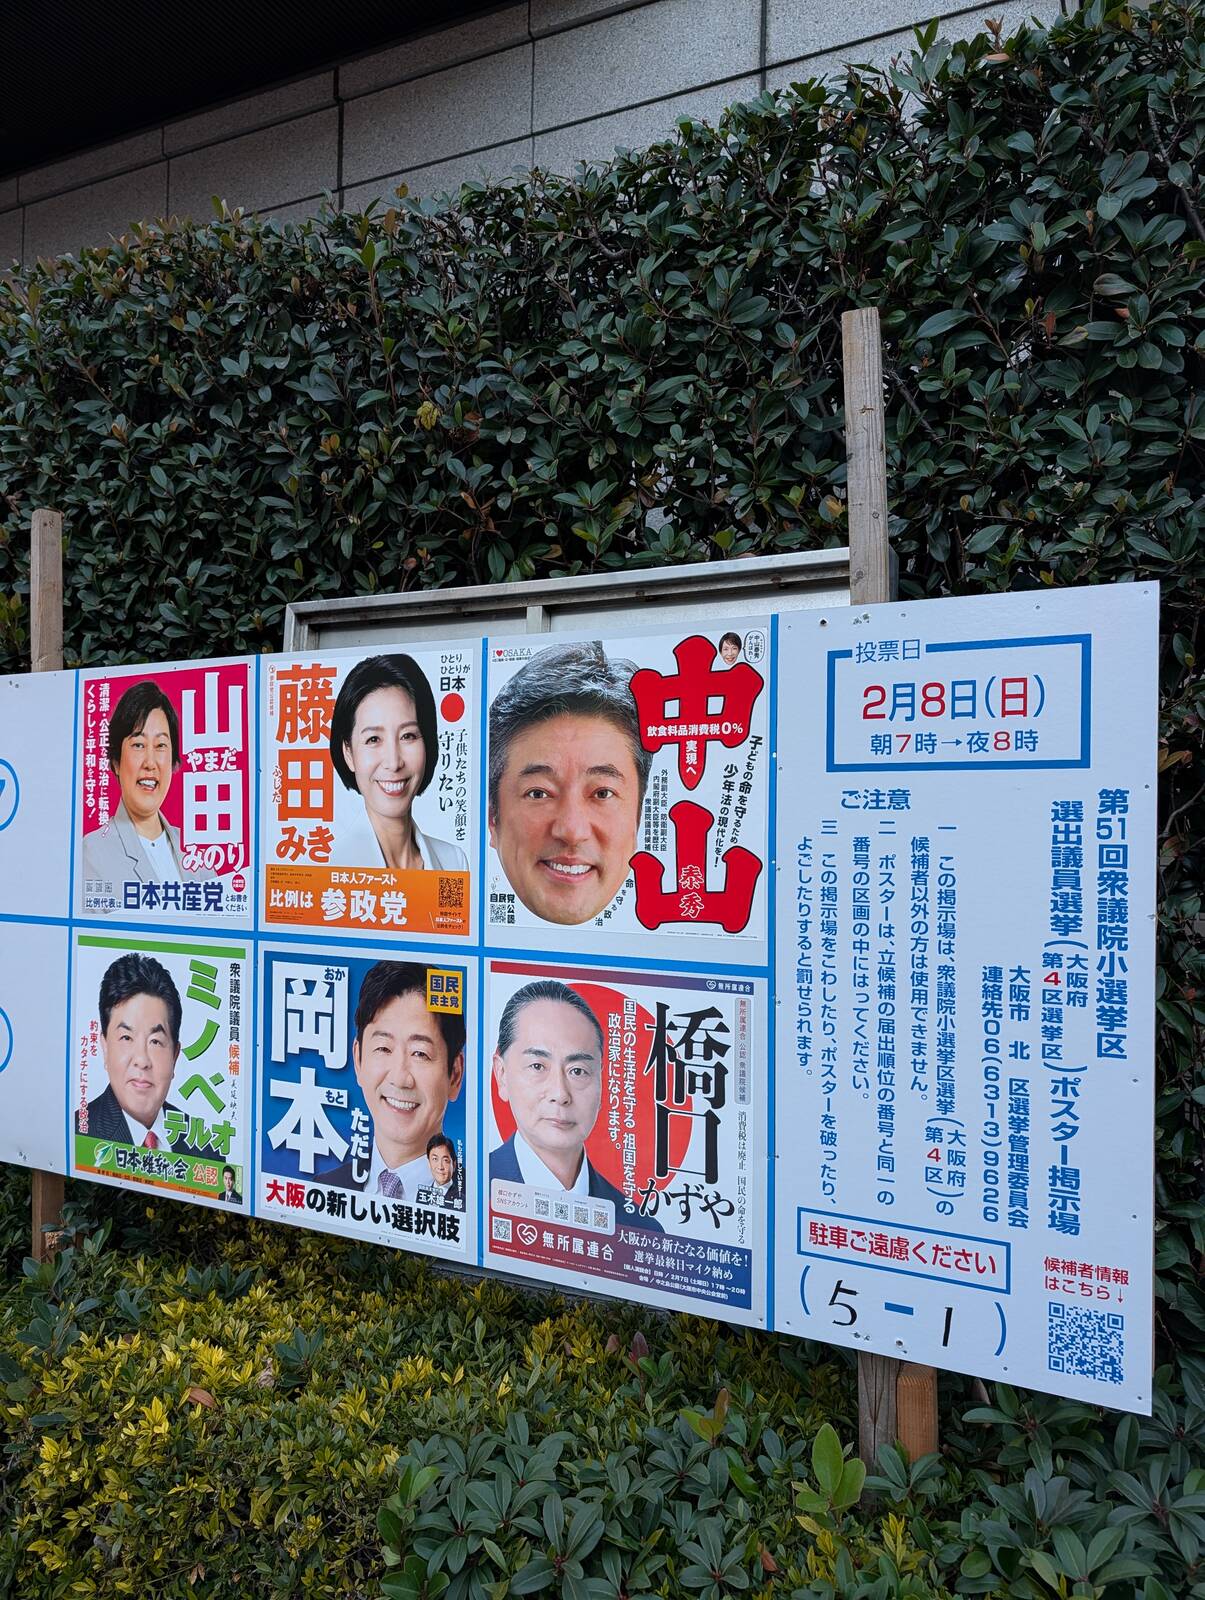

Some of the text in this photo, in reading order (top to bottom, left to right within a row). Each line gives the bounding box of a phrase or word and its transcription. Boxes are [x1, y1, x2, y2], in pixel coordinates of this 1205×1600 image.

[441, 654, 462, 663] ひとり
[441, 664, 470, 674] ひとりが
[503, 648, 532, 657] OSAKA
[856, 639, 921, 663] 投票日
[440, 676, 465, 692] 日本
[862, 674, 1045, 722] 2月8日(日)
[276, 663, 337, 822] 藤田
[647, 722, 743, 737] 飲食料品消費税0%
[870, 729, 1039, 756] 朝7時 夜8時
[181, 672, 243, 846] 山田
[187, 748, 237, 772] やまだ
[438, 731, 454, 812] 守りたい
[685, 740, 698, 775] 実現へ
[272, 766, 283, 804] ふじた
[454, 729, 467, 841] 子供たちの笑顔を
[629, 634, 764, 933] 中山
[730, 735, 763, 844] 子どもの命を守るため
[841, 789, 911, 811] ご注意
[714, 763, 739, 867] 少年法の現代化を!
[182, 843, 245, 872] みのり
[276, 825, 335, 862] みき
[85, 898, 121, 908] 比例代表は
[123, 881, 224, 911] 日本共産党
[331, 872, 397, 885] 日本人ファースト
[490, 893, 515, 904] 自民党
[679, 865, 704, 919] 泰秀
[225, 903, 247, 912] ください
[269, 888, 408, 925] 比例は 参政党
[507, 904, 515, 924] 公認
[1096, 788, 1130, 1059] 第51回衆議院小選挙区
[324, 967, 345, 981] おか
[796, 836, 814, 1076] よごしたりすると罰せられます。
[852, 836, 870, 1099] 番号の区画の中にはってください。
[910, 836, 930, 1101] 候補者以外の方は使用できません。
[429, 994, 460, 1009] 民主党
[430, 974, 460, 994] 国民
[718, 982, 751, 993] 無所属連合
[1066, 953, 1088, 1007] 大阪府
[228, 963, 241, 1076] 衆議院議員候補
[820, 819, 838, 1204] 三 この掲示場をこわしたり、ポスターを破ったり、
[877, 820, 897, 1206] 二 ポスターは、立候補の届出順位の番号と同一の
[1041, 953, 1063, 1060] 第4区選挙区
[89, 1020, 99, 1056] 約束を
[178, 959, 226, 1114] ミノベ
[1009, 1041, 1030, 1060] 北
[79, 1035, 89, 1133] カタチにする政治
[267, 960, 350, 1174] 岡本
[607, 1012, 622, 1151] 政治家になります。
[325, 1090, 345, 1105] もと
[622, 998, 637, 1215] 国民の生活を守る 祖国を守る
[643, 1000, 732, 1185] 橋口
[981, 966, 1003, 1223] 連絡先06(6313)9626
[163, 1110, 237, 1156] テルオ
[350, 1107, 371, 1185] ただし
[924, 1127, 944, 1182] 第4区
[1008, 1078, 1030, 1229] 区選挙管理委員会
[115, 1147, 189, 1182] 日本維新の会
[193, 1163, 218, 1186] 公認
[737, 1111, 747, 1245] 消費税は廃止 国民の命を守る
[946, 1130, 967, 1188] 大阪府
[265, 1178, 461, 1244] 大阪の新しい選択肢
[418, 1191, 463, 1209] 玉木雄一郎
[637, 1178, 736, 1229] かずや
[542, 1230, 614, 1261] 無所属連合
[617, 1229, 749, 1267] 大阪から新たなる価値を!
[634, 1250, 733, 1281] 選挙最終日マイク納め
[808, 1221, 998, 1276] 駐車ご遠慮ください
[1044, 1256, 1129, 1286] 候補者情報
